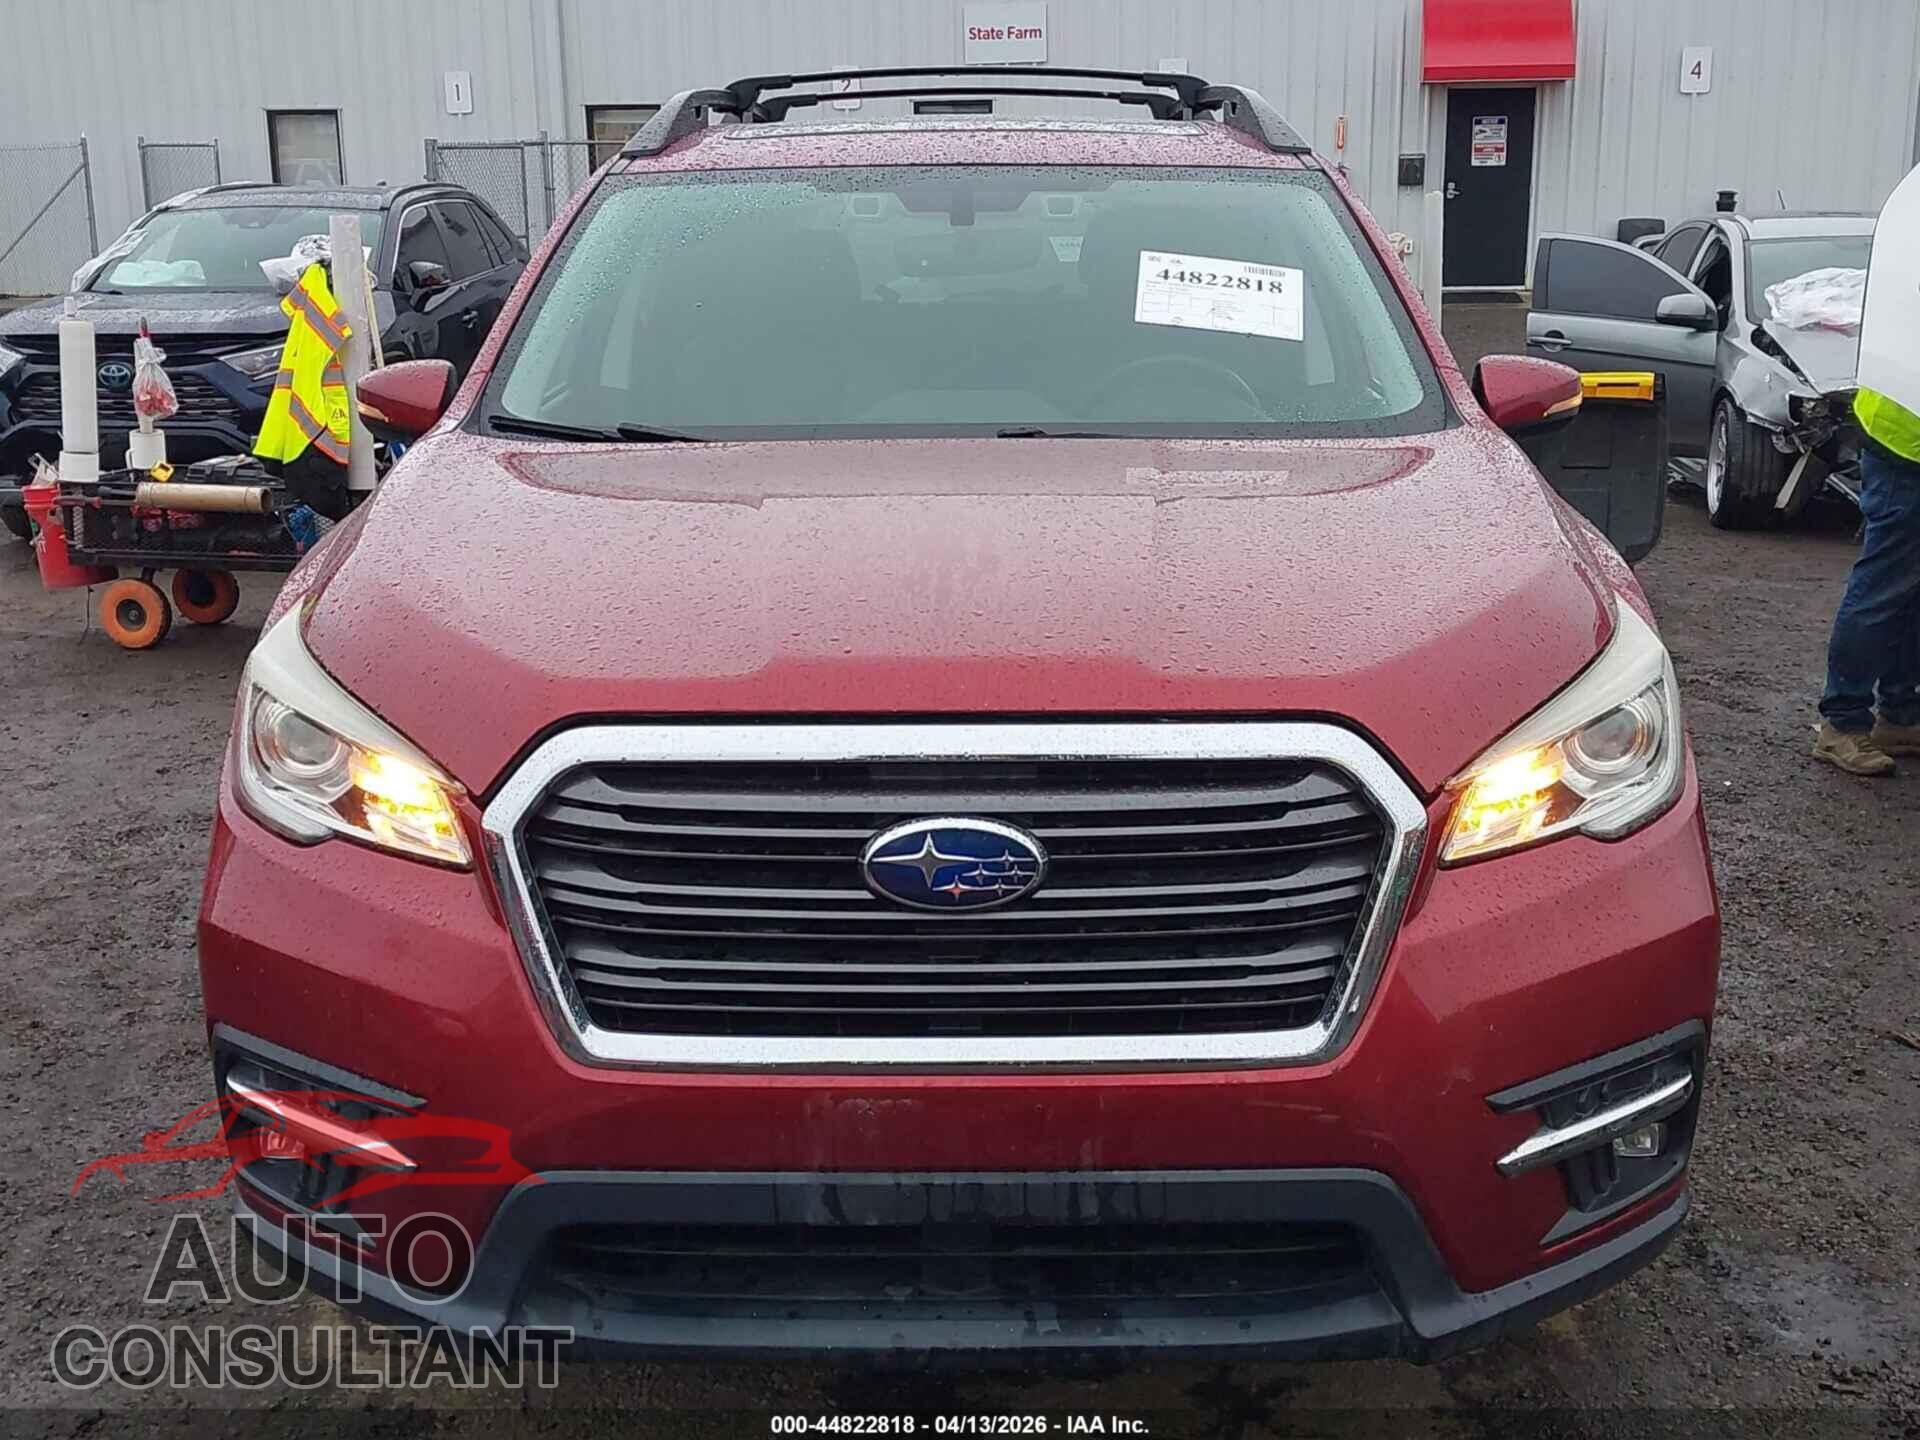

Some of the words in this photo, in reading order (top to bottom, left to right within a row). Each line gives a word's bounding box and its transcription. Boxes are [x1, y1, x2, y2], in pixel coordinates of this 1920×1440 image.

[968, 26, 1004, 41] State
[1007, 25, 1043, 40] Farm
[1690, 60, 1702, 80] 4
[455, 83, 461, 101] 1
[1156, 268, 1283, 295] 44822818
